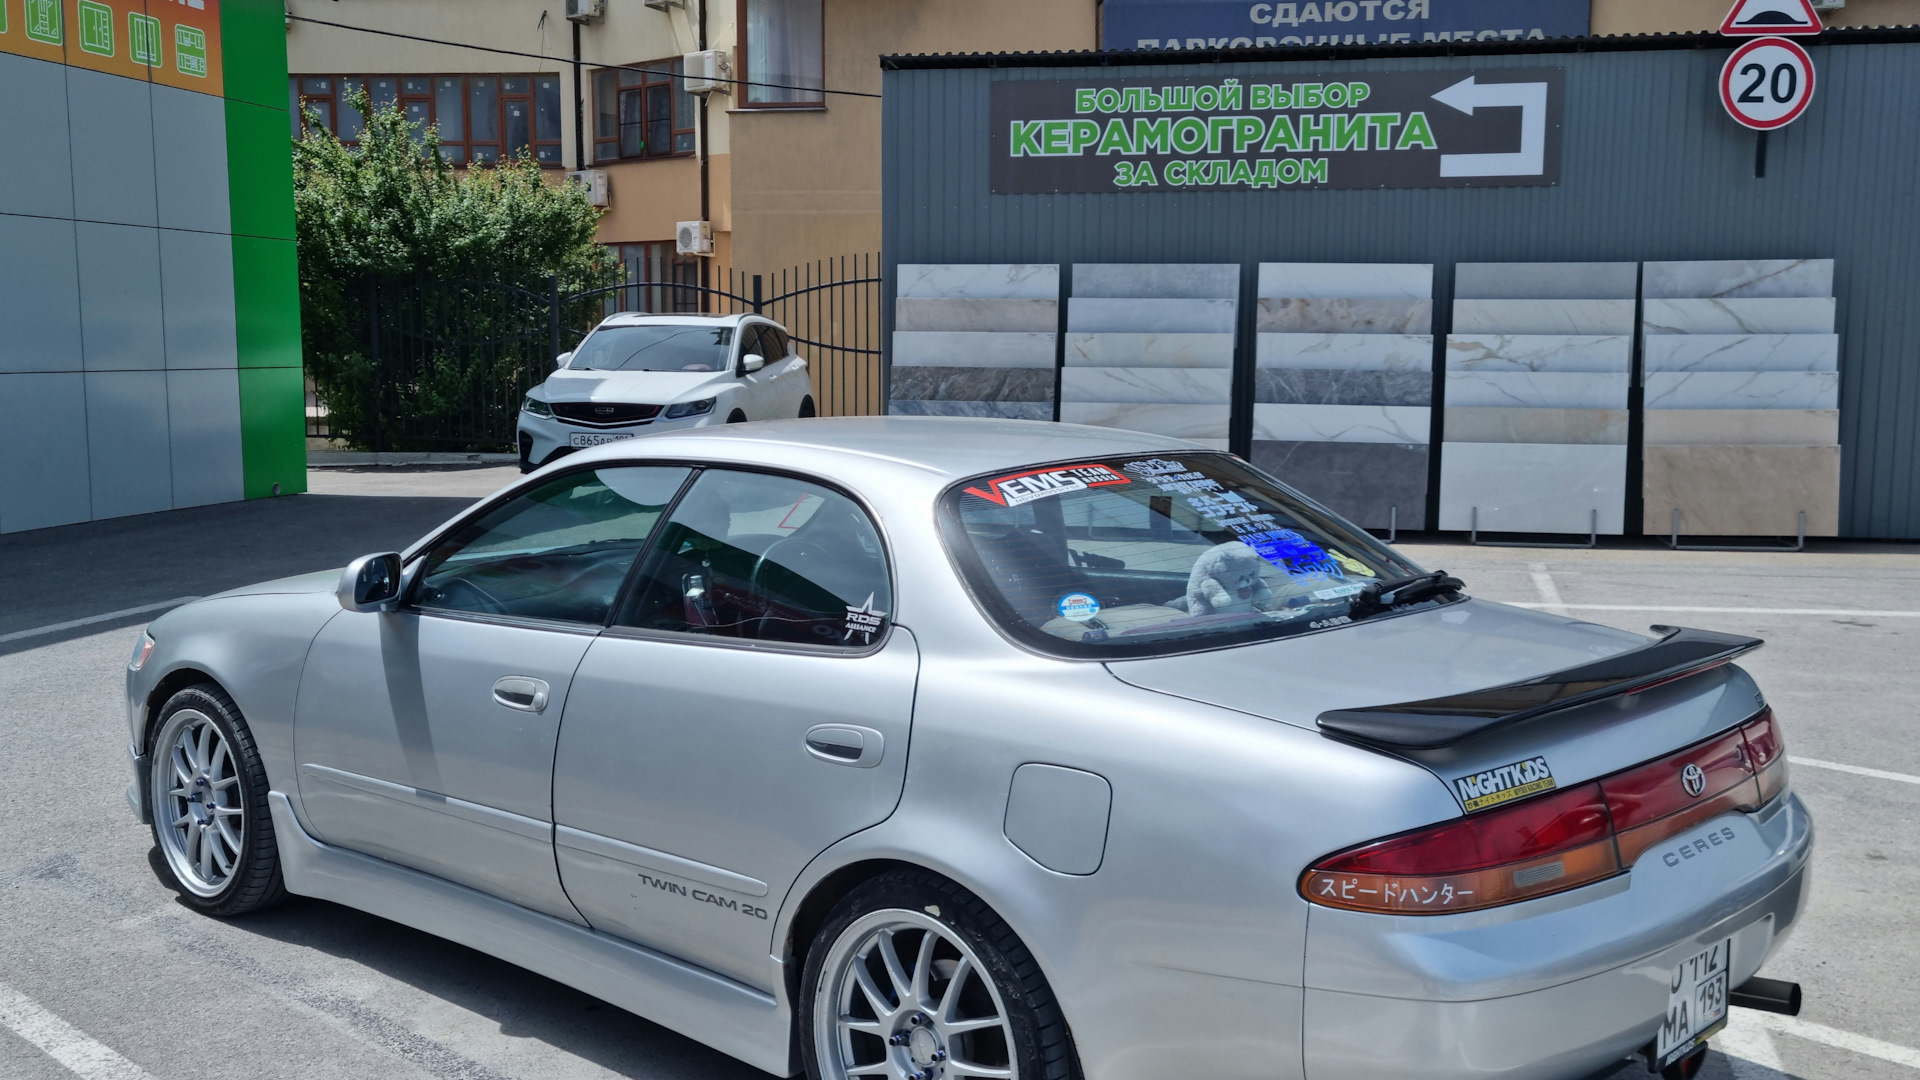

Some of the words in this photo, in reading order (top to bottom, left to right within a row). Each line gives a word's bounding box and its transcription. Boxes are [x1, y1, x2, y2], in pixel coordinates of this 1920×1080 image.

[1250, 0, 1430, 27] СДАЮТСЯ
[1075, 79, 1242, 113] БОЛЬШОЙ
[1250, 82, 1370, 110] ВЫБОР
[1737, 63, 1797, 103] 20
[1010, 111, 1437, 157] КЕРАМОГРАНИТА
[1113, 160, 1157, 187] ЗА
[1164, 158, 1328, 188] СКЛАДОМ
[1071, 467, 1112, 478] TEAM
[845, 612, 882, 626] RDS
[845, 622, 877, 634] ALLIANCE
[1662, 827, 1735, 867] CERES
[638, 873, 687, 897] TWIN
[692, 889, 737, 911] CAM
[741, 903, 768, 920] 20
[1320, 878, 1473, 905] スピードハンター
[1699, 976, 1723, 1014] 193
